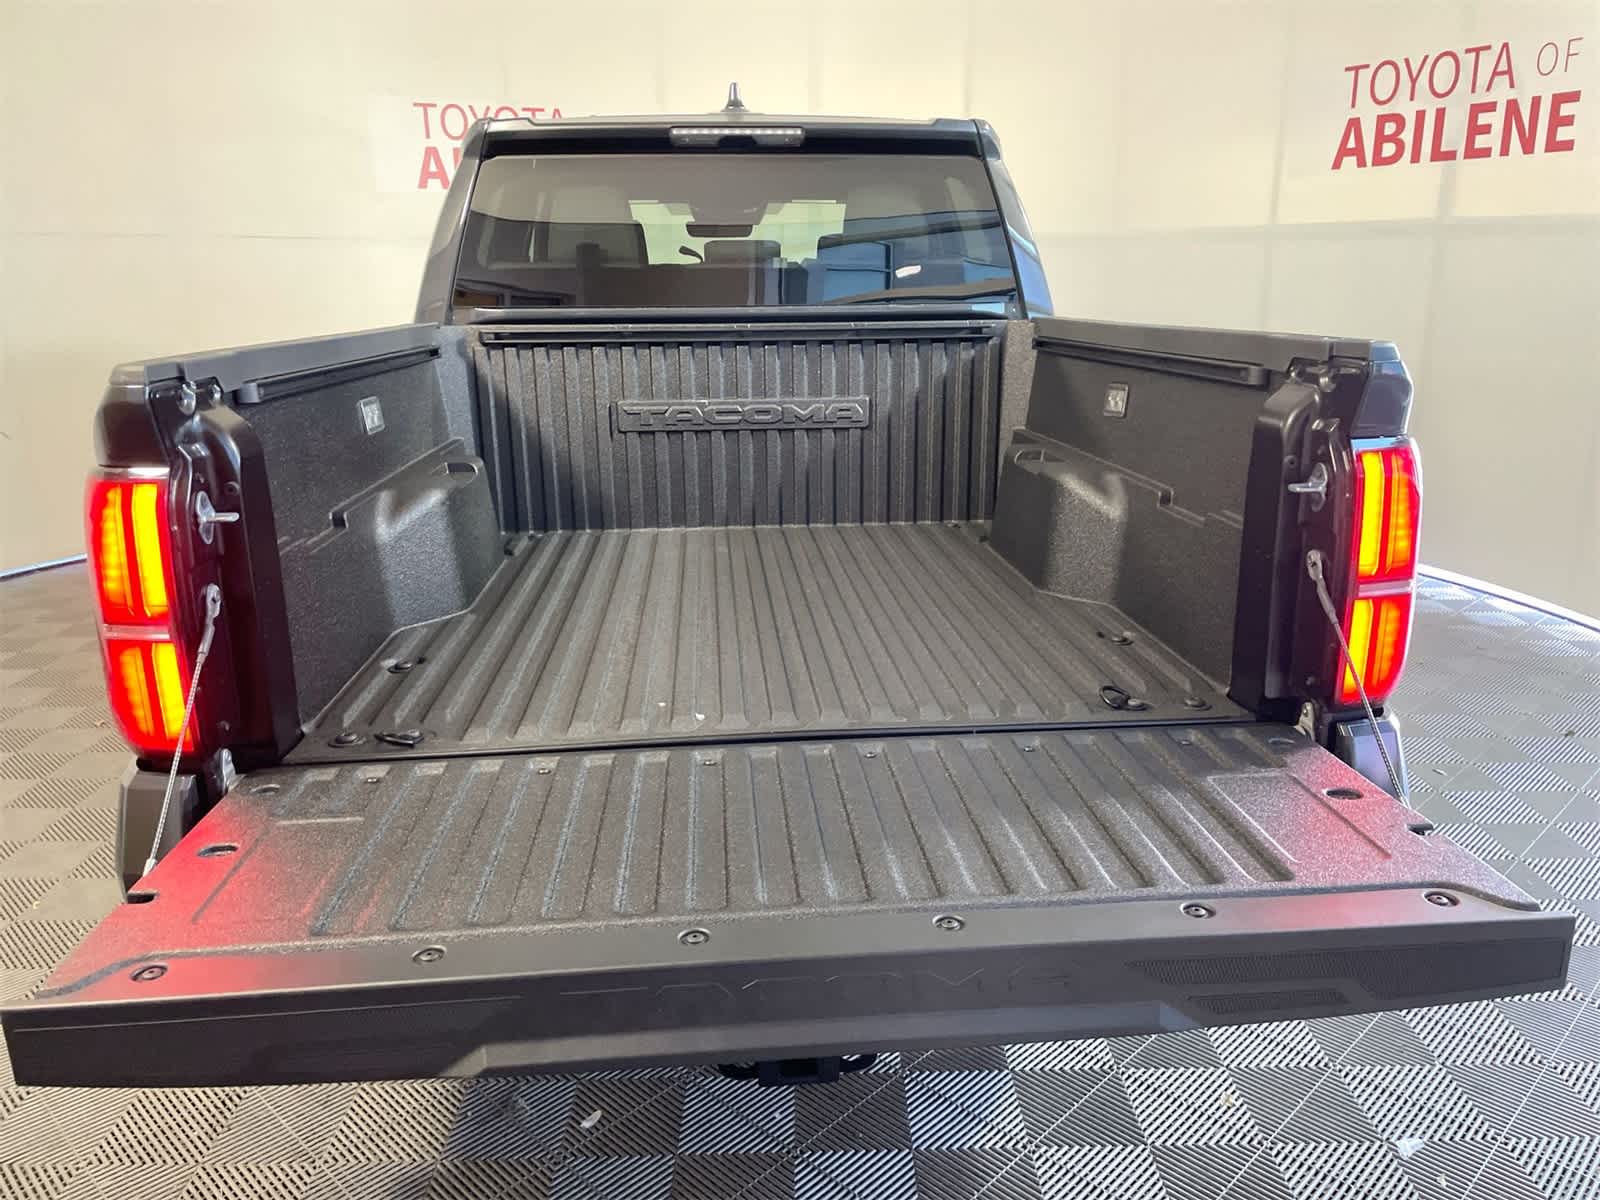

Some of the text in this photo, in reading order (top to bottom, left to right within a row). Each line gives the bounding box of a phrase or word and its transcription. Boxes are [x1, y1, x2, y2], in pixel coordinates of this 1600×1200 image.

[1344, 37, 1584, 109] TOYOTA OF
[1331, 90, 1582, 170] ABILENE
[622, 402, 865, 426] TACOMA
